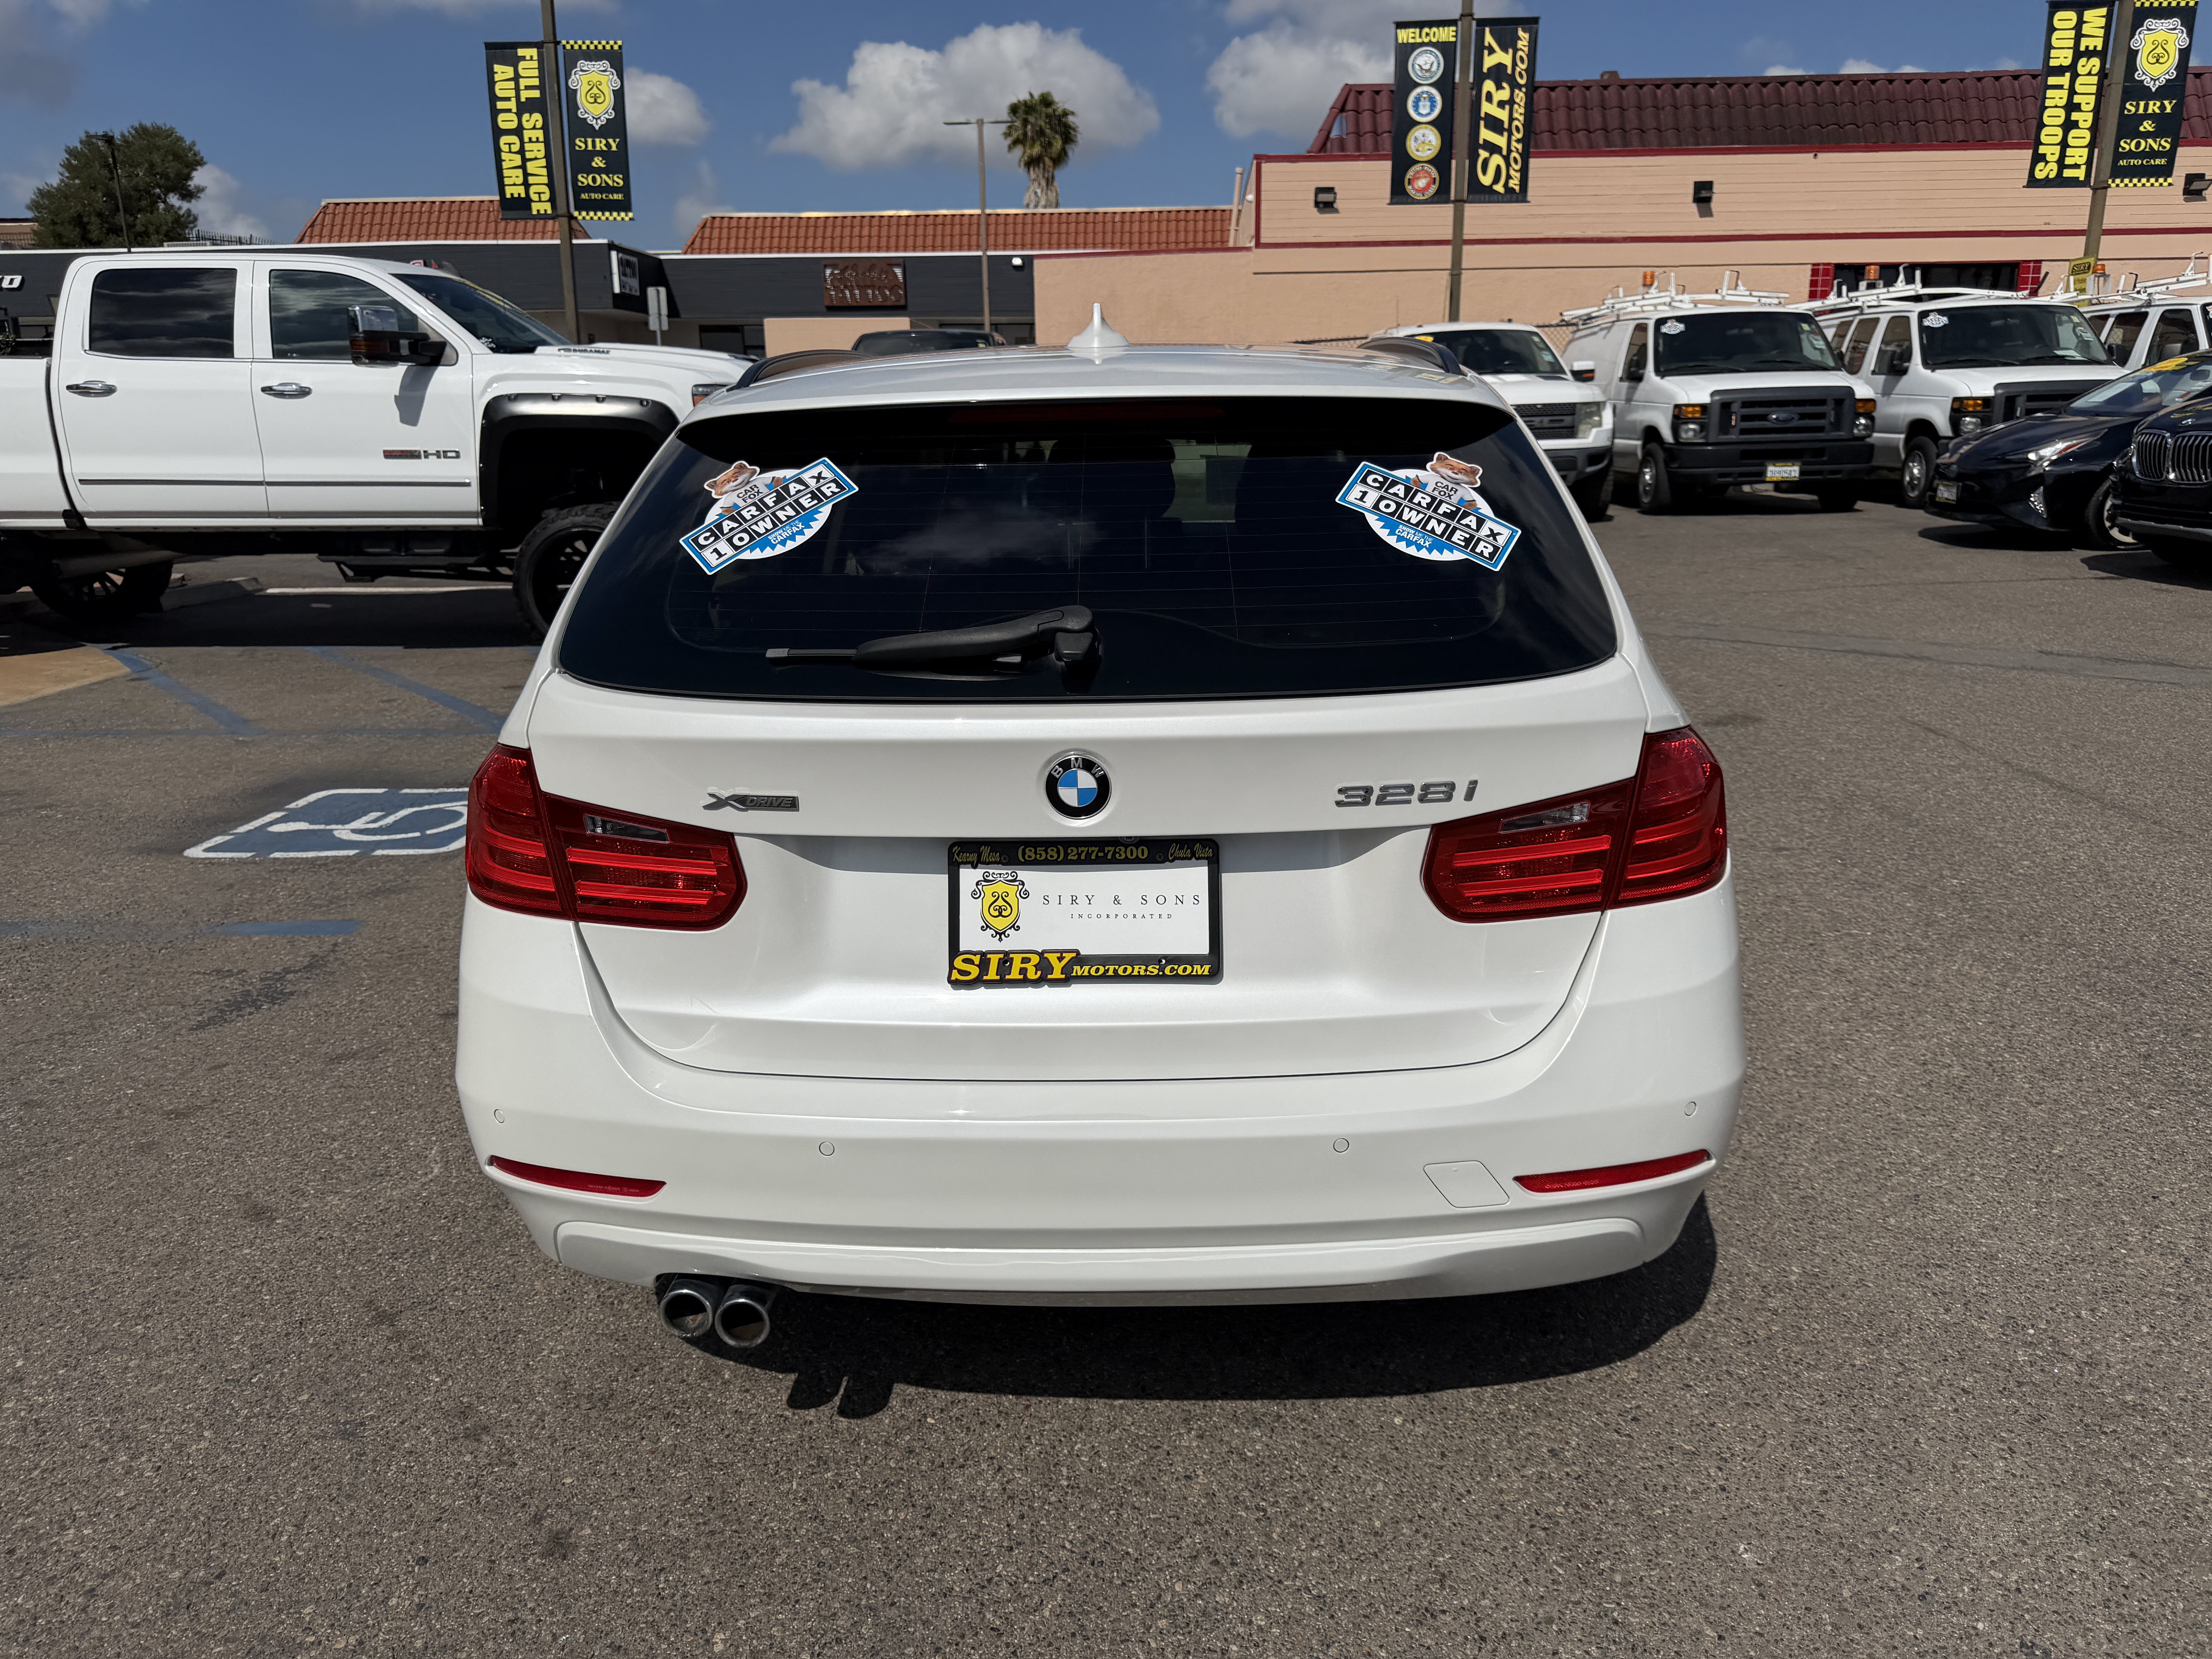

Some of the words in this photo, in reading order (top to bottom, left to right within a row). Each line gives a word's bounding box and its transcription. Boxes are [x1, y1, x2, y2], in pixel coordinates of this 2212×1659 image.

[1397, 27, 1456, 43] WELCOME
[2049, 11, 2077, 66] OUR
[2080, 7, 2107, 51] WE
[517, 48, 540, 102] FULL
[493, 64, 518, 129] AUTO
[1477, 27, 1513, 194] SIRY
[1508, 27, 1530, 193] MOTORS.COM
[2124, 100, 2177, 115] SIRY
[2034, 72, 2071, 179] TROOPS
[2063, 57, 2100, 180] SUPPORT
[2139, 120, 2156, 132] &
[575, 138, 620, 151] SIRY
[2119, 137, 2172, 152] SONS
[499, 135, 526, 198] CARE
[522, 113, 552, 215] SERVICE
[591, 156, 606, 167] &
[577, 174, 624, 187] SONS
[423, 449, 461, 459] HD
[736, 484, 759, 500] CAR
[742, 489, 764, 504] FOX
[1433, 487, 1453, 500] FOX
[1435, 481, 1458, 494] CAR
[697, 470, 829, 546] CARFAX
[1366, 474, 1505, 544] CARFAX
[709, 546, 727, 561] 1
[732, 483, 842, 547] OWNER
[1355, 489, 1368, 503] 1
[1378, 500, 1494, 558] OWNER
[1399, 525, 1415, 534] SHOW
[771, 522, 805, 544] CARFAX
[1396, 529, 1432, 548] CARFAX
[1051, 758, 1104, 778] BMW
[1334, 779, 1478, 807] 328i
[953, 846, 977, 866] Kearny
[980, 845, 1000, 862] Mesa
[1018, 845, 1064, 861] (858)
[1068, 845, 1149, 860] 277-7300
[1168, 843, 1191, 860] Chula
[1194, 843, 1213, 857] Vista
[1042, 895, 1095, 905] SIRY
[1113, 895, 1122, 905] &
[1140, 895, 1200, 905] SONS
[951, 952, 1079, 981] SIRY
[1071, 965, 1211, 976] MOTORS.COM
